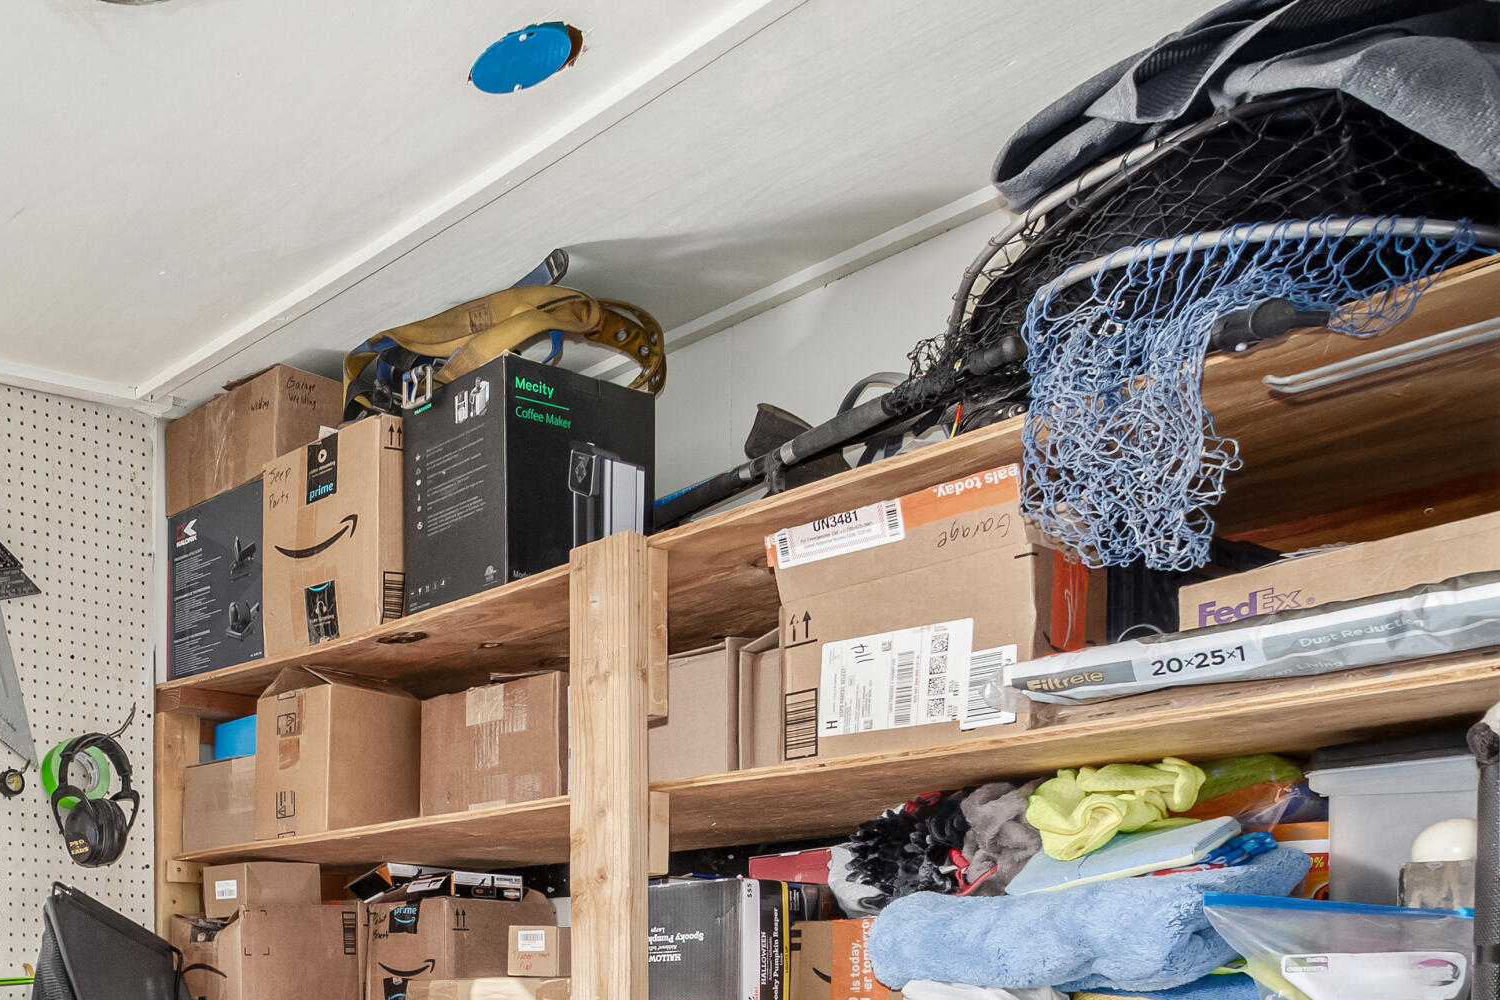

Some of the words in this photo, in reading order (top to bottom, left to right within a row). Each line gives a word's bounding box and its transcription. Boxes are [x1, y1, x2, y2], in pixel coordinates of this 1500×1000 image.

[515, 376, 554, 399] Mecity
[515, 405, 544, 423] Coffee
[545, 411, 572, 430] Maker
[932, 471, 983, 499] today.
[984, 465, 1021, 485] eals
[308, 481, 334, 502] prime
[812, 509, 859, 533] UN3481
[936, 512, 1012, 549] Garage
[1198, 586, 1303, 628] FedEx
[1300, 631, 1339, 649] Dust
[1340, 617, 1425, 641] Reduction
[1026, 669, 1105, 694] Filtrete
[648, 932, 675, 945] Pumpk
[648, 953, 682, 963] HALLOW
[772, 938, 780, 977] Pumpkin
